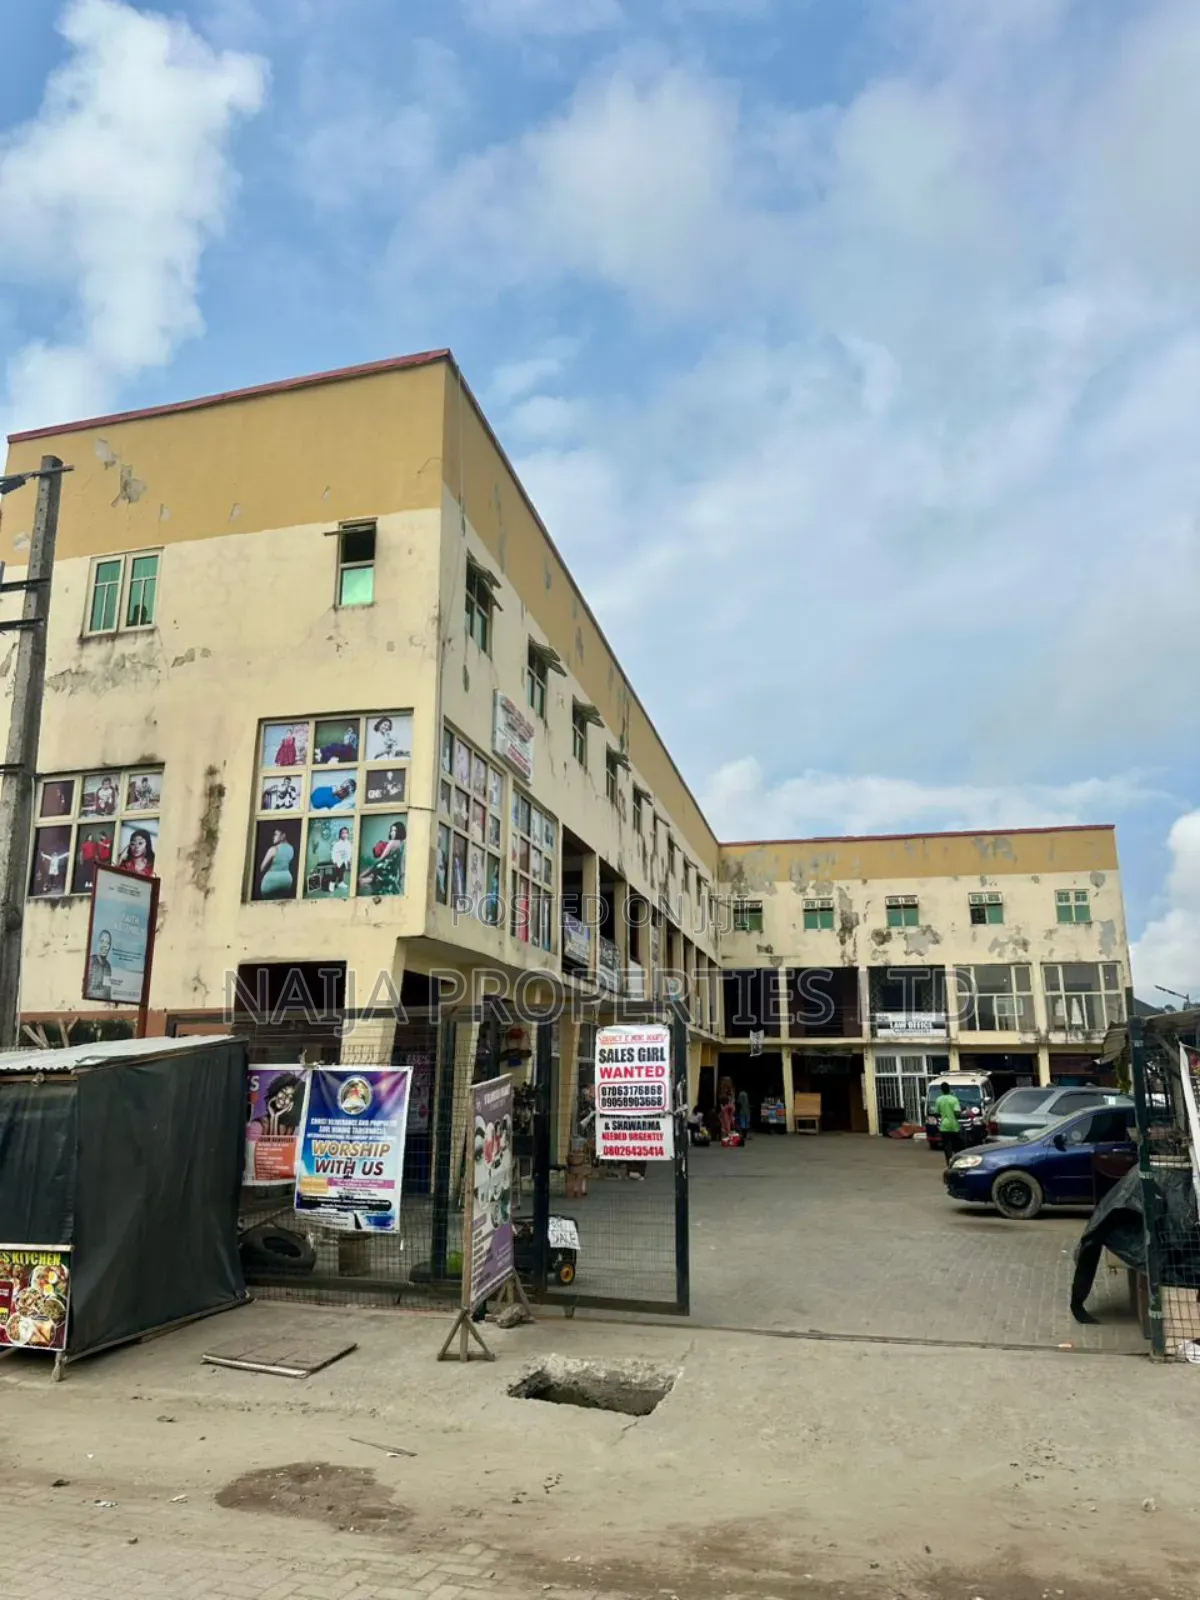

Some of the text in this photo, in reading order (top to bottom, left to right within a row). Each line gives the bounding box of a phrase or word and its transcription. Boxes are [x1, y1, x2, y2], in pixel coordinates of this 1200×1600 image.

[599, 1046, 666, 1063] SALES GIRL
[600, 1066, 666, 1079] WANTED
[612, 1120, 661, 1131] SHAWARMA
[602, 1132, 664, 1141] NEEDED URGENTLY
[312, 1140, 391, 1158] WORSHIP
[315, 1159, 384, 1176] WITH US
[12, 1251, 61, 1266] KITCHEN
